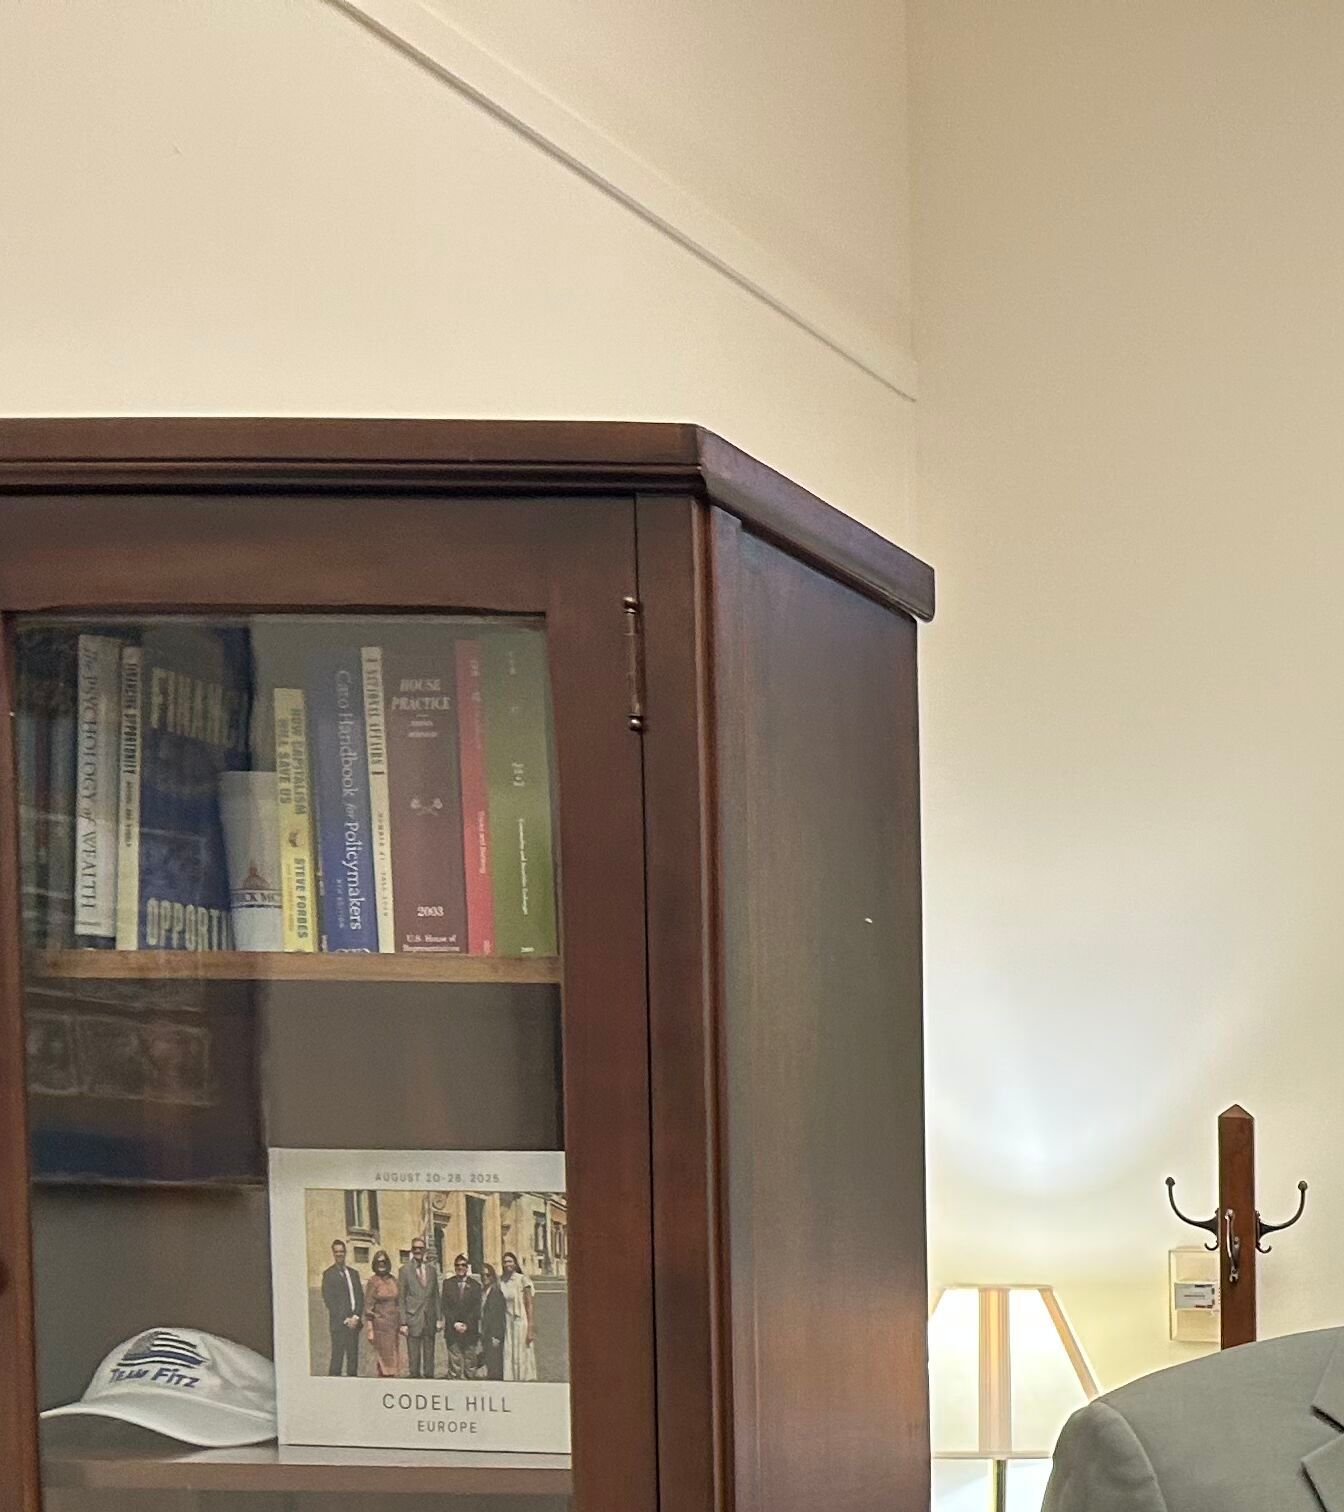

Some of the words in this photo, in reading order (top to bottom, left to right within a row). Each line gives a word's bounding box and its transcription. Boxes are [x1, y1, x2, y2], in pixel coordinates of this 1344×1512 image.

[400, 678, 441, 692] HOUSE
[391, 696, 452, 712] PRACTICE
[81, 675, 98, 801] PSYCHOLOGY
[336, 712, 360, 798] Handbook
[80, 830, 99, 910] WEALTH
[293, 857, 307, 892] STEVE
[341, 822, 366, 931] Policymakers
[296, 894, 310, 940] FORBES
[375, 1172, 420, 1183] AUGUST
[469, 1173, 501, 1184] 2025
[382, 1393, 455, 1412] CODEL
[465, 1395, 512, 1414] HILL
[416, 1420, 479, 1434] EUROPE
